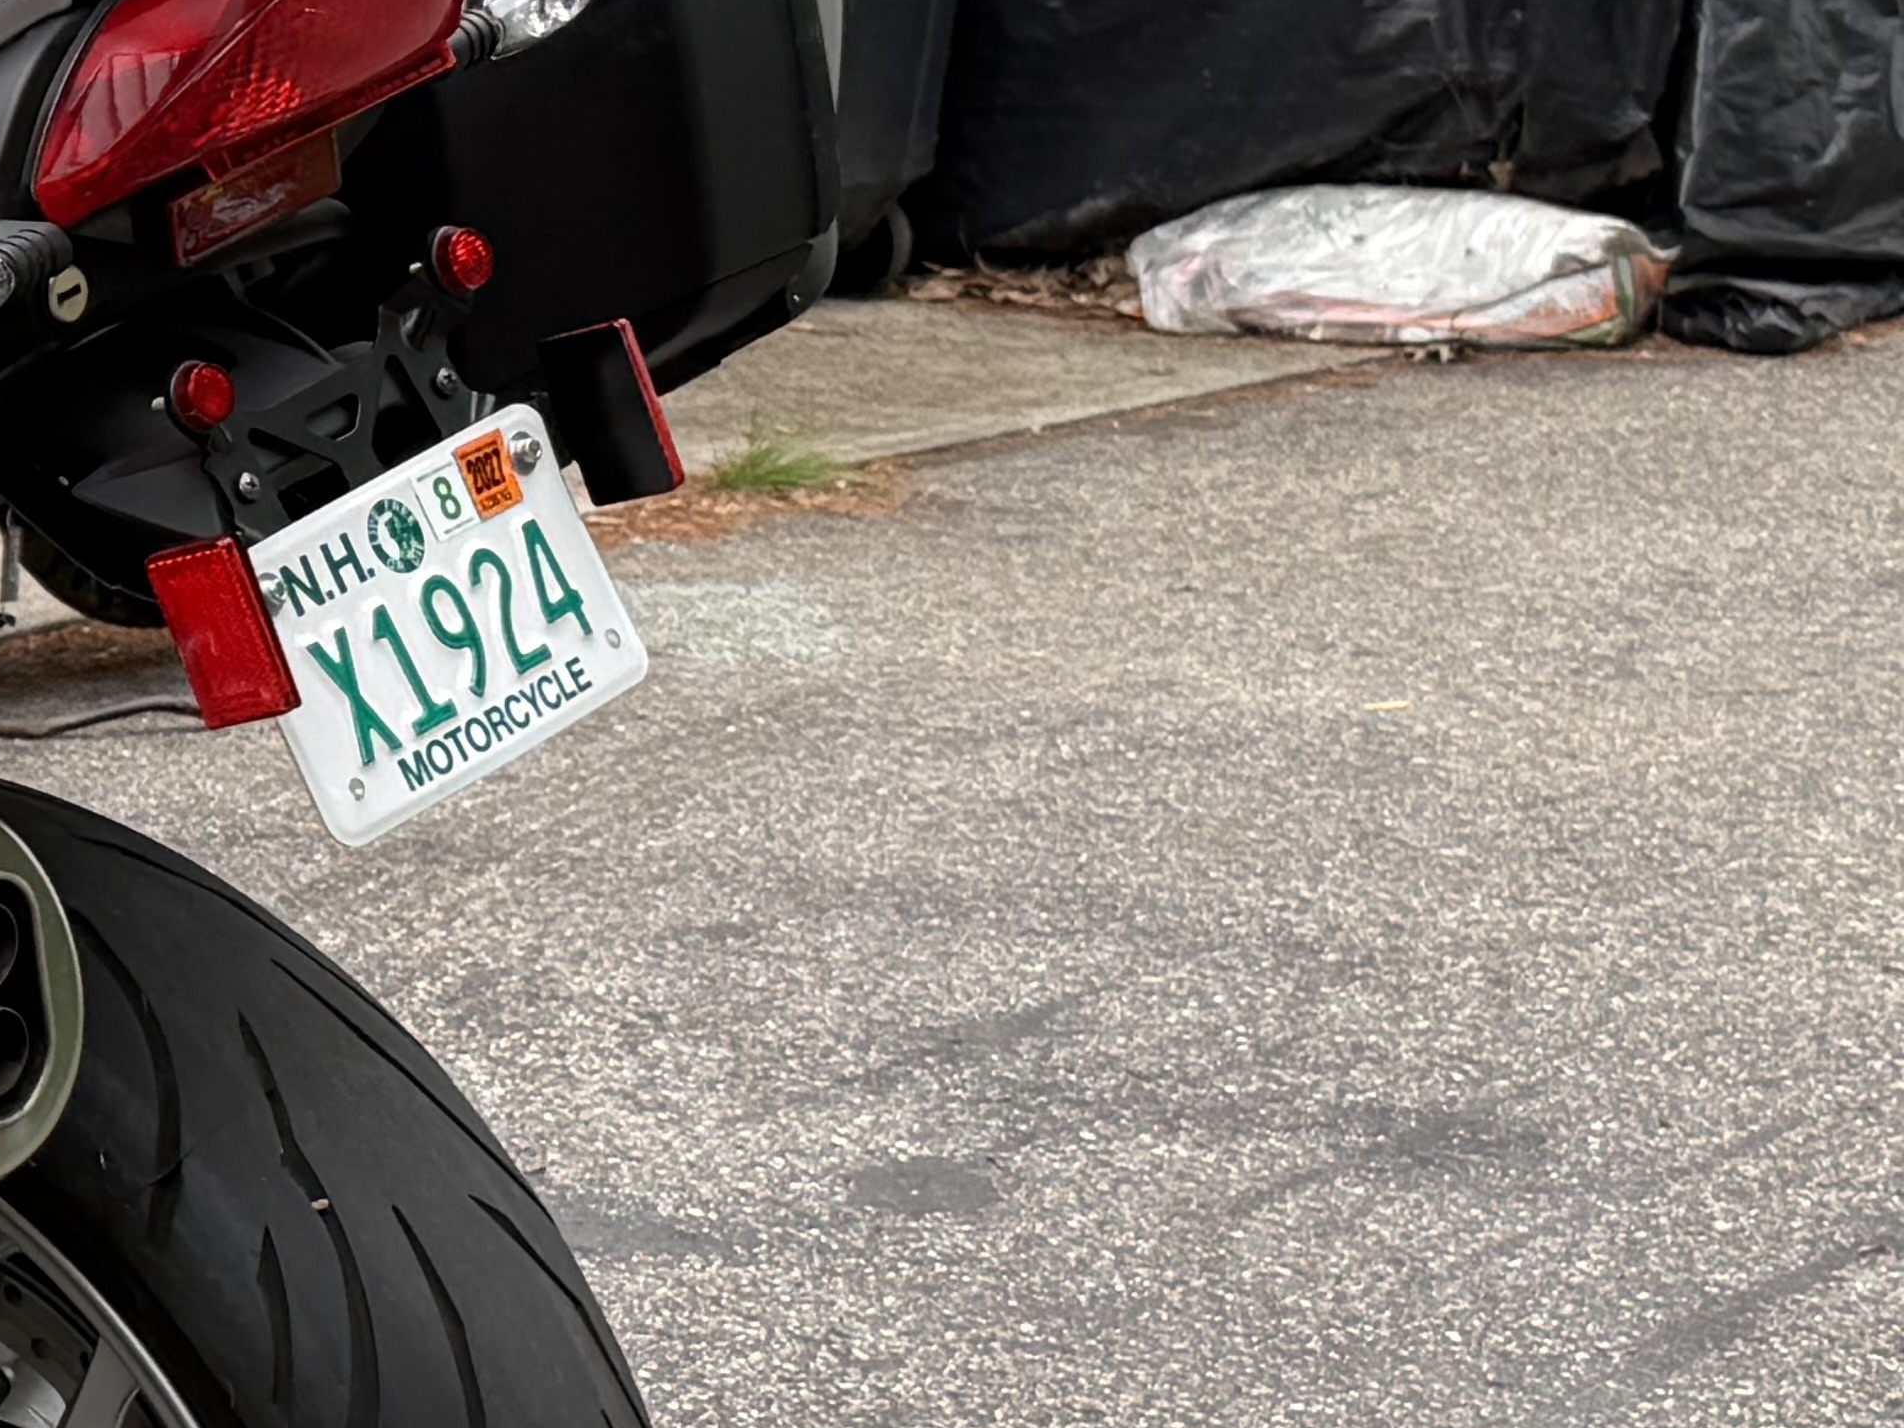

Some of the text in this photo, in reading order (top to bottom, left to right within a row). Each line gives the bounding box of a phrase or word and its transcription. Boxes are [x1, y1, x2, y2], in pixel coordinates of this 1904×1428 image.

[432, 475, 461, 521] 8
[466, 447, 508, 496] 2027
[280, 532, 376, 616] N.H.
[306, 519, 593, 766] X1924
[397, 656, 593, 792] MOTORCYCLE
